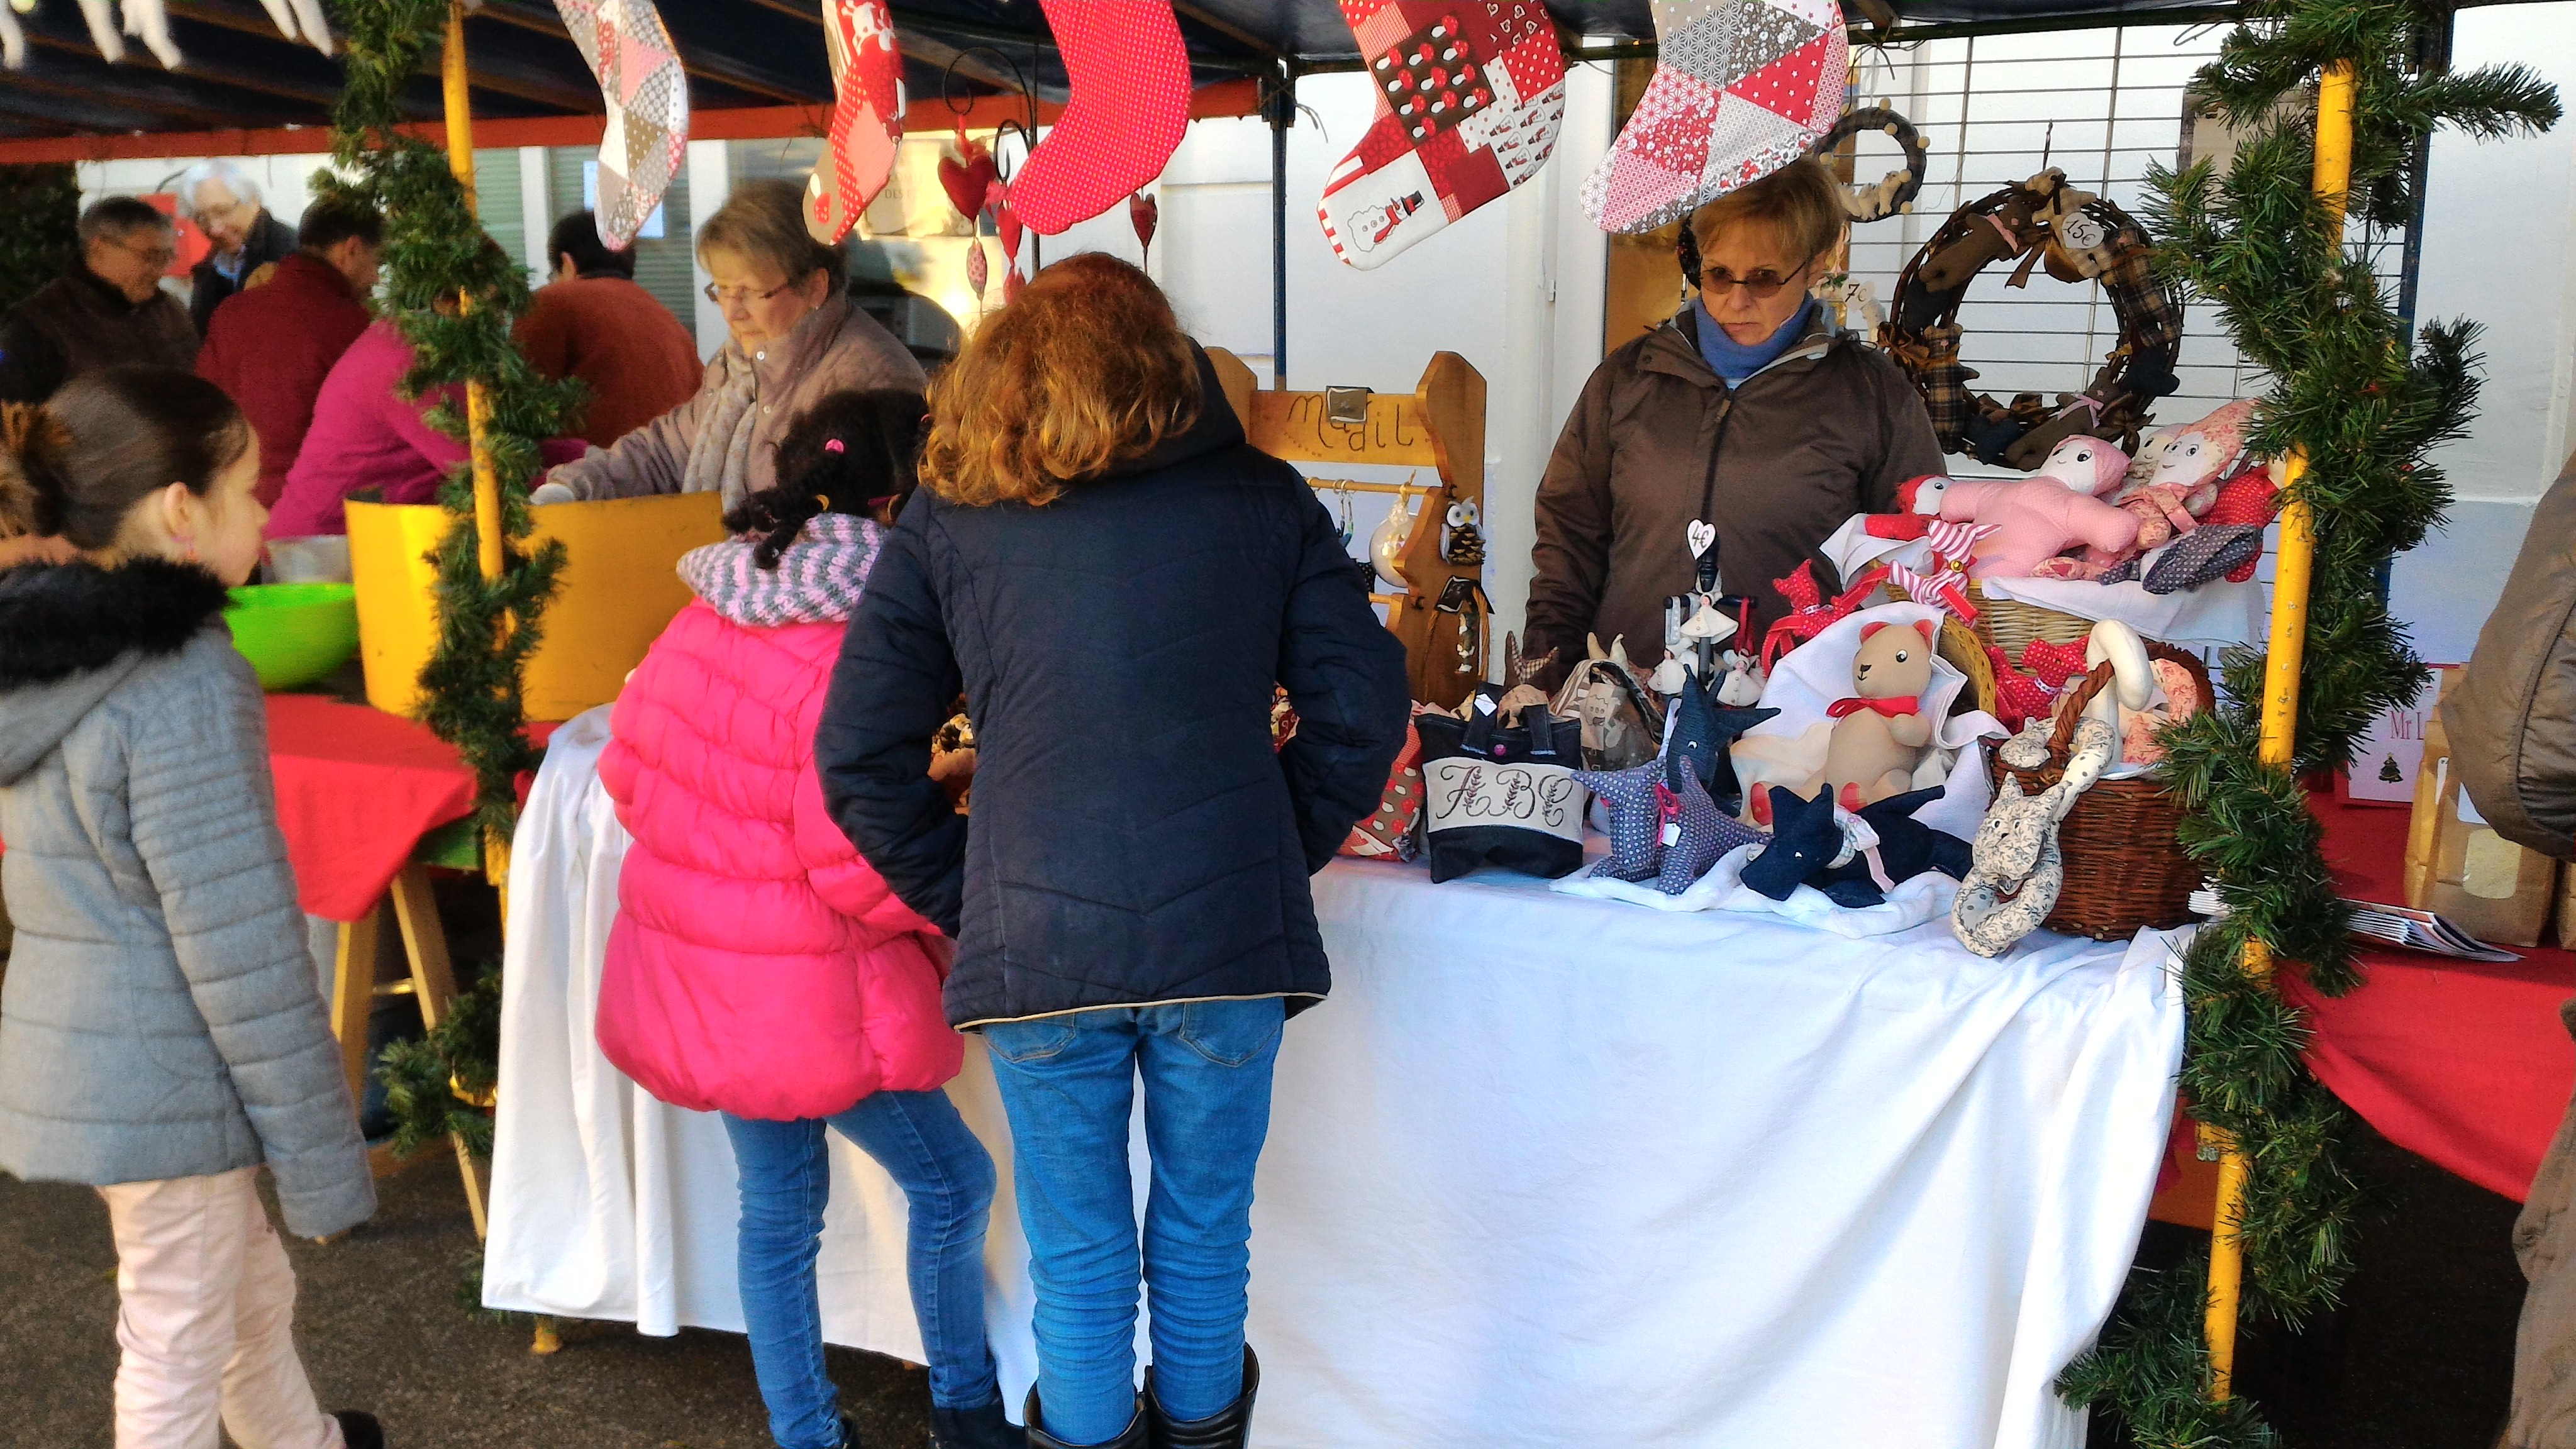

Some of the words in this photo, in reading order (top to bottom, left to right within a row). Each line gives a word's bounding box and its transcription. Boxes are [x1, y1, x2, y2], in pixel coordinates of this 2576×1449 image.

[2063, 219, 2096, 247] 15€
[1691, 524, 1709, 549] 4€
[2390, 710, 2412, 740] Mr
